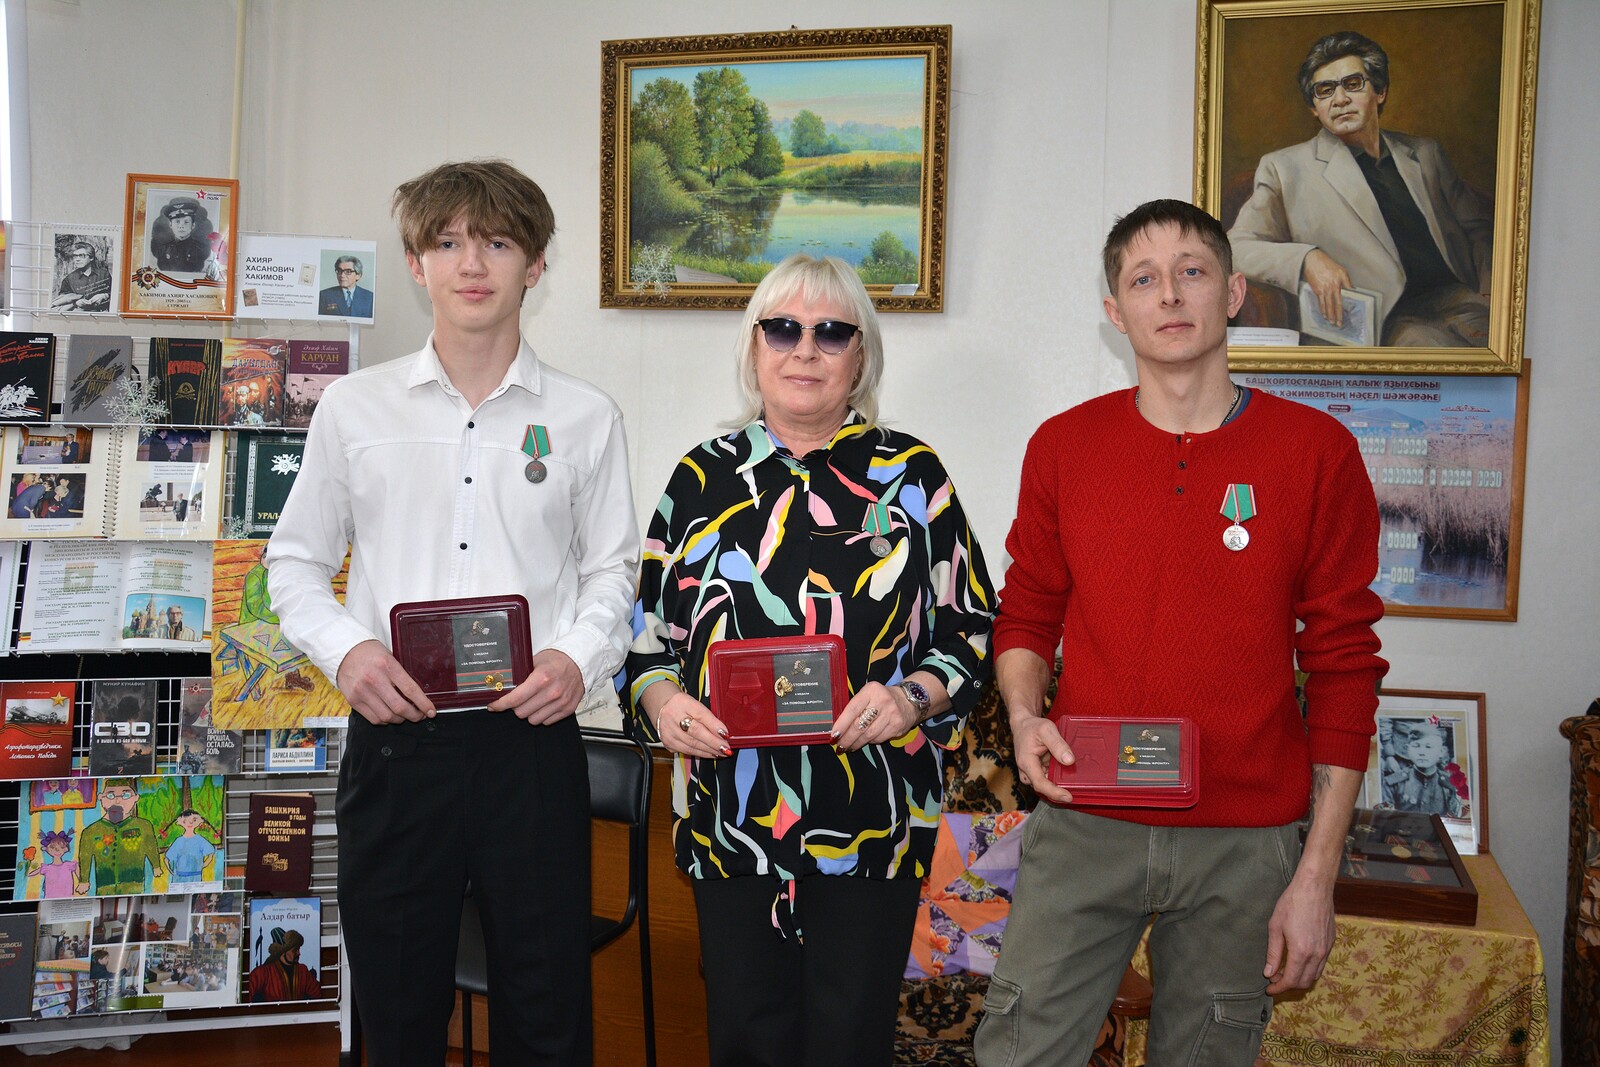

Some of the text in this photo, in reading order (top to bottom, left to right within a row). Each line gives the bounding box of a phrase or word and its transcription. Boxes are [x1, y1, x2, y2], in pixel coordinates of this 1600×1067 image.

[245, 265, 295, 273] ХАСАНОВИЧ
[245, 273, 284, 281] ХАКИМОВ
[301, 353, 339, 362] КАРУАН
[94, 721, 151, 737] СВО
[265, 806, 301, 814] БАШКИРИЯ
[264, 820, 291, 828] ВЕЛИКОЙ
[260, 912, 311, 921] Алдар батыр
